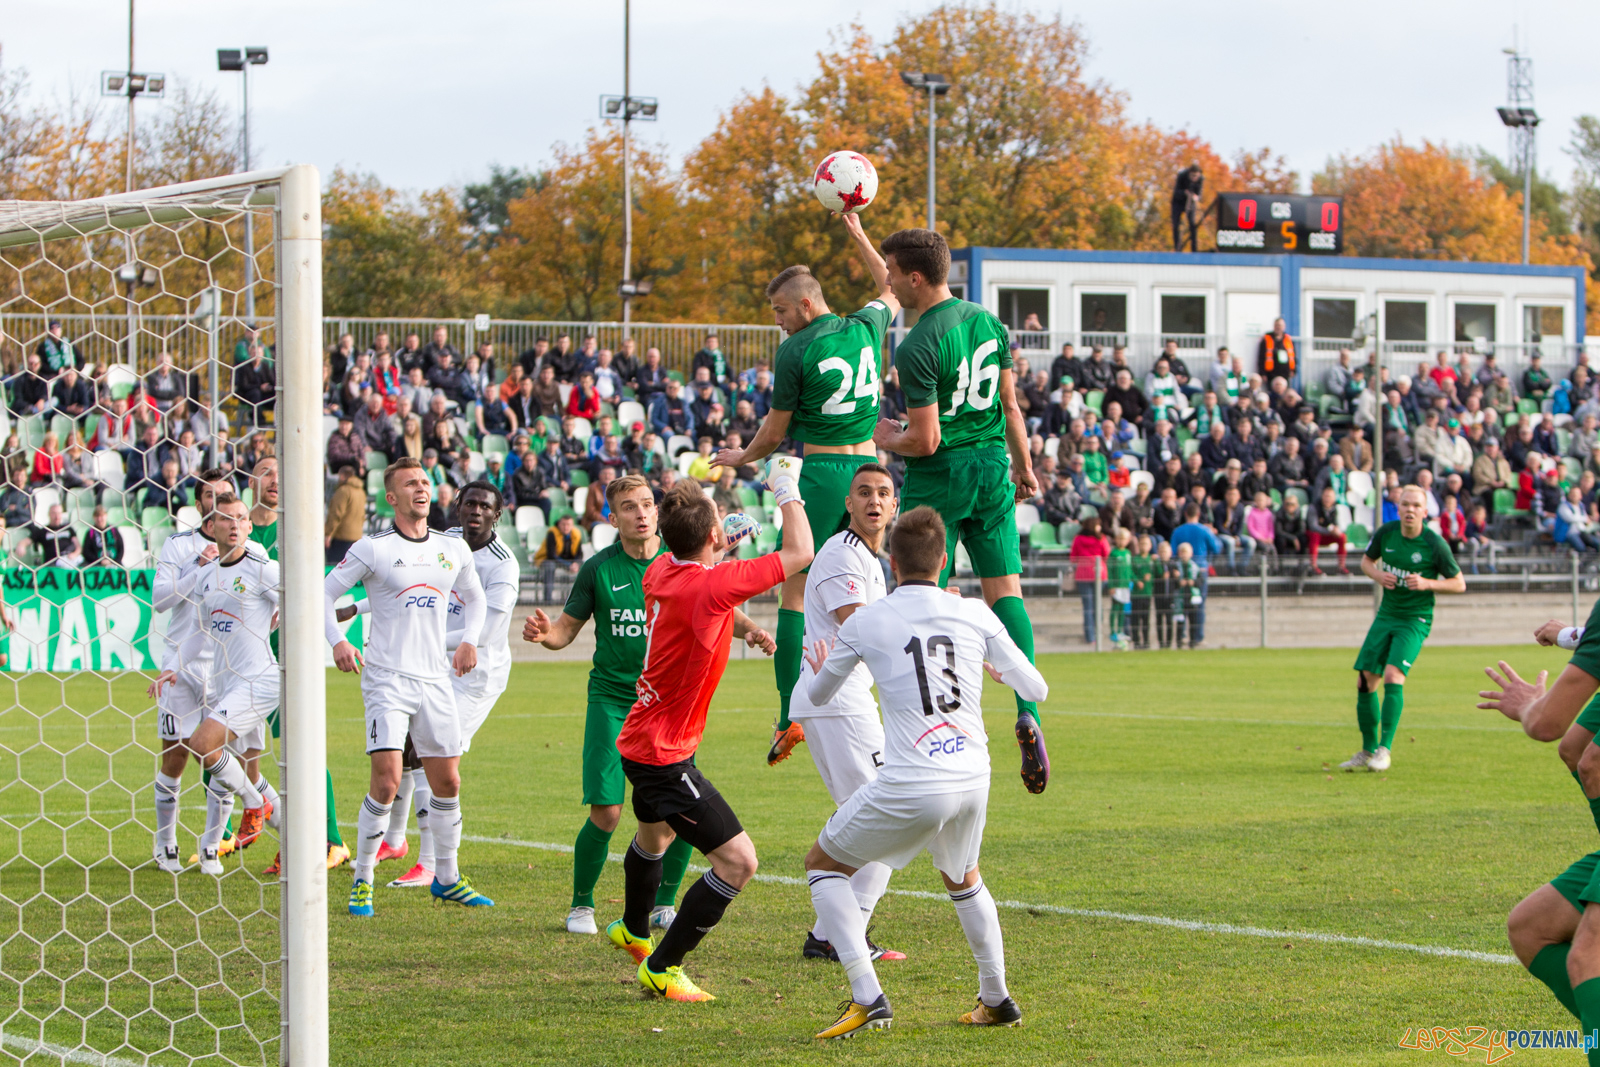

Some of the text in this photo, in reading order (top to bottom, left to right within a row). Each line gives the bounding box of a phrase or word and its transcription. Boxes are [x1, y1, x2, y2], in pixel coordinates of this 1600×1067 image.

[1238, 199, 1257, 229] 0
[1321, 202, 1340, 232] 0
[1281, 221, 1298, 249] 5
[818, 346, 880, 414] 24
[942, 338, 1000, 416] 16
[405, 596, 437, 608] PGE
[447, 602, 462, 615] GE
[212, 621, 233, 632] PGE
[904, 635, 961, 716] 13
[370, 719, 377, 744] 4
[929, 736, 967, 757] PGE
[681, 772, 701, 799] 1
